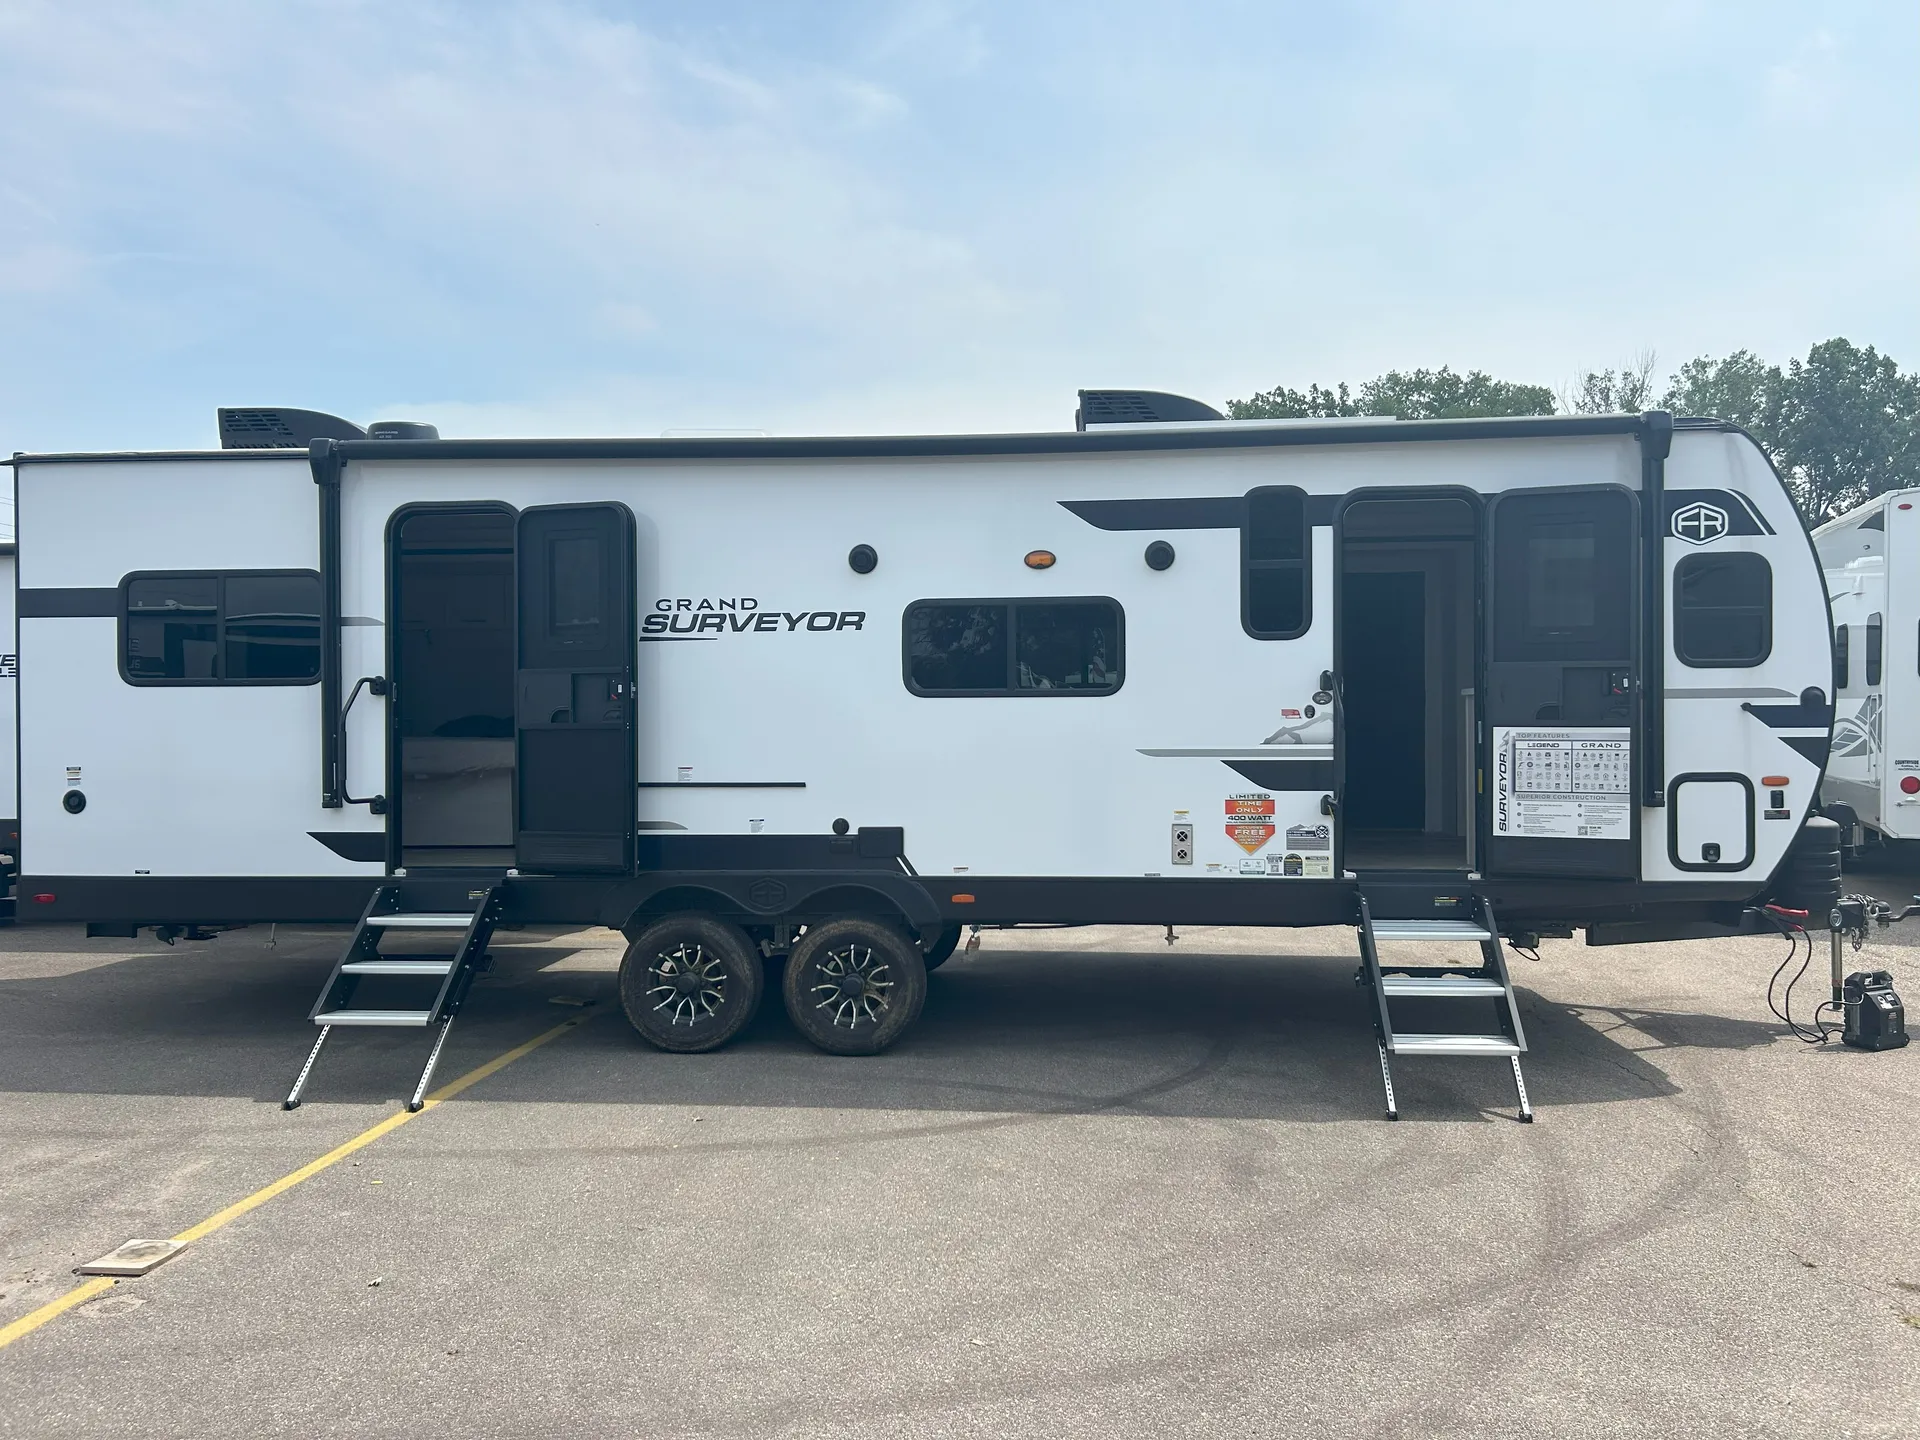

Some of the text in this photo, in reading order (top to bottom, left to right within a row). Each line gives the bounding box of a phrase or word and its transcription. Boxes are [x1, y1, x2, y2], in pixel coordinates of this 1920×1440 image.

[656, 599, 758, 611] GRAND
[642, 612, 866, 633] SURVEYOR
[1499, 753, 1507, 832] SURVEYOR
